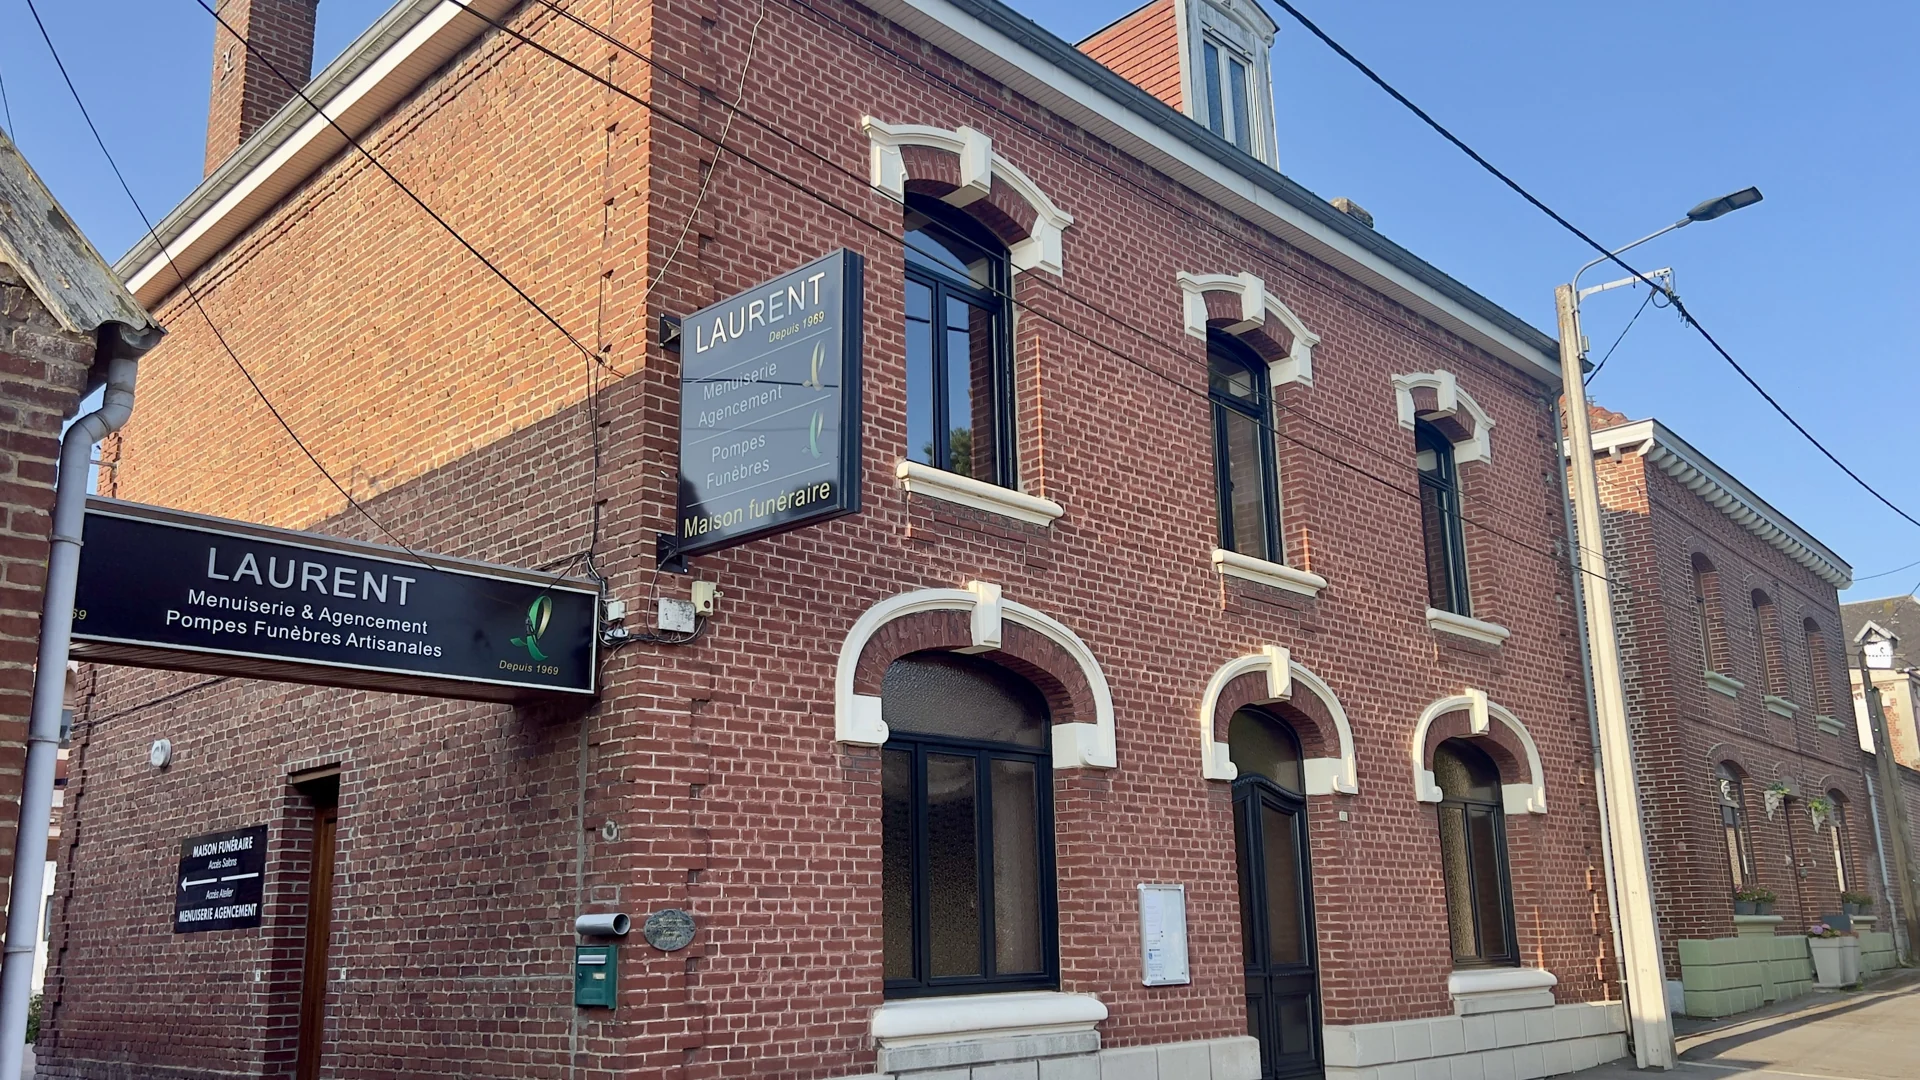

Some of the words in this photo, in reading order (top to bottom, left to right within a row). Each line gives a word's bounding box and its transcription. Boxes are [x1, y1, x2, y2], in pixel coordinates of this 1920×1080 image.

[696, 271, 826, 354] LAURENT
[768, 322, 800, 343] Depuis
[803, 310, 825, 329] 1969
[703, 361, 777, 401] Menuiserie
[698, 384, 783, 428] Agencement
[711, 434, 766, 463] Pompes
[706, 459, 770, 490] Funèbres
[684, 507, 743, 539] Maison
[749, 481, 831, 520] funéraire
[207, 547, 416, 606] LAURENT
[188, 588, 295, 617] Menuiserie
[301, 604, 314, 620] &
[318, 607, 428, 635] Agencement
[166, 609, 248, 635] Pompes
[254, 620, 341, 646] Funèbres
[345, 632, 442, 657] Artisanales
[499, 659, 533, 673] Depuis
[536, 664, 559, 676] 1969
[192, 842, 218, 858] MAISON
[218, 836, 253, 853] FUNÉRAIRE
[178, 907, 213, 923] MENUISERIE
[214, 903, 257, 919] AGENCEMENT
